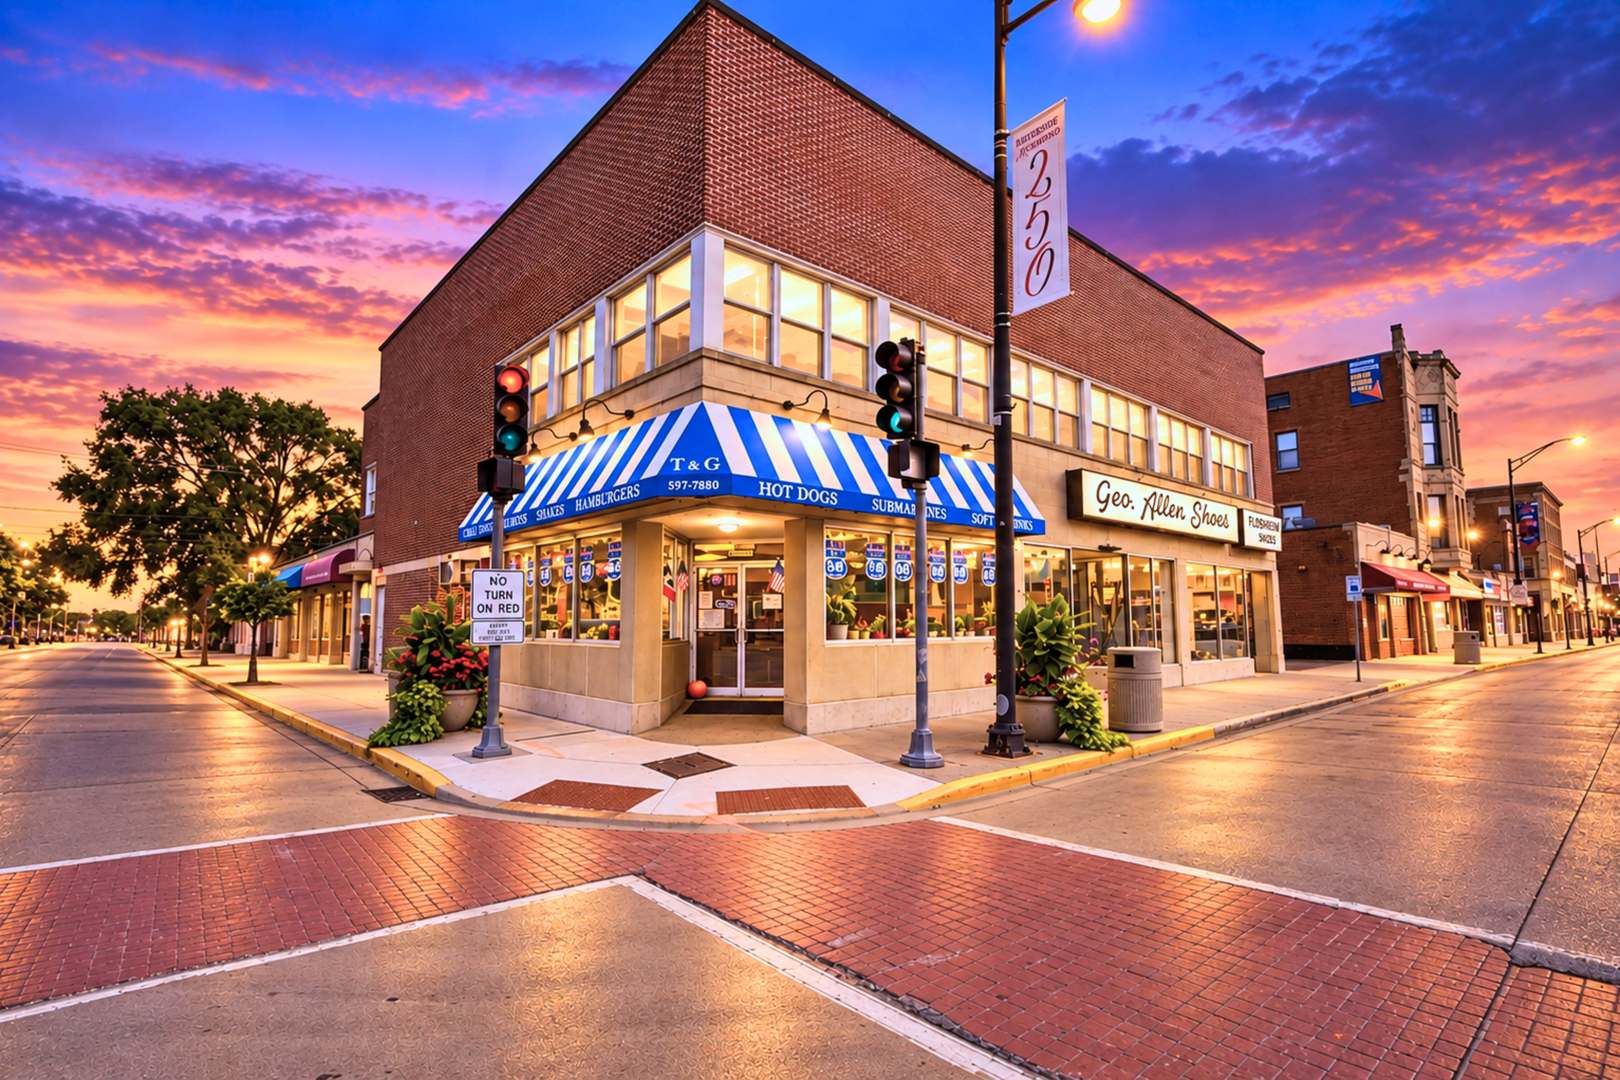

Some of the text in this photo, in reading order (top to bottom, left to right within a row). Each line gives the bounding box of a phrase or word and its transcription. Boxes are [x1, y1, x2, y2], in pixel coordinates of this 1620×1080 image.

[670, 456, 721, 471] T & G
[668, 480, 720, 490] 597-7880
[575, 483, 640, 512] HAMBURGERS
[759, 481, 793, 499] HOT
[797, 486, 838, 505] DOGS
[872, 498, 947, 520] SUBMARNES
[971, 512, 995, 526] SOFT
[1096, 480, 1230, 529] Geo. Allen Shoes
[489, 576, 507, 586] NO
[485, 590, 513, 600] TURN
[477, 603, 520, 613] ON RED
